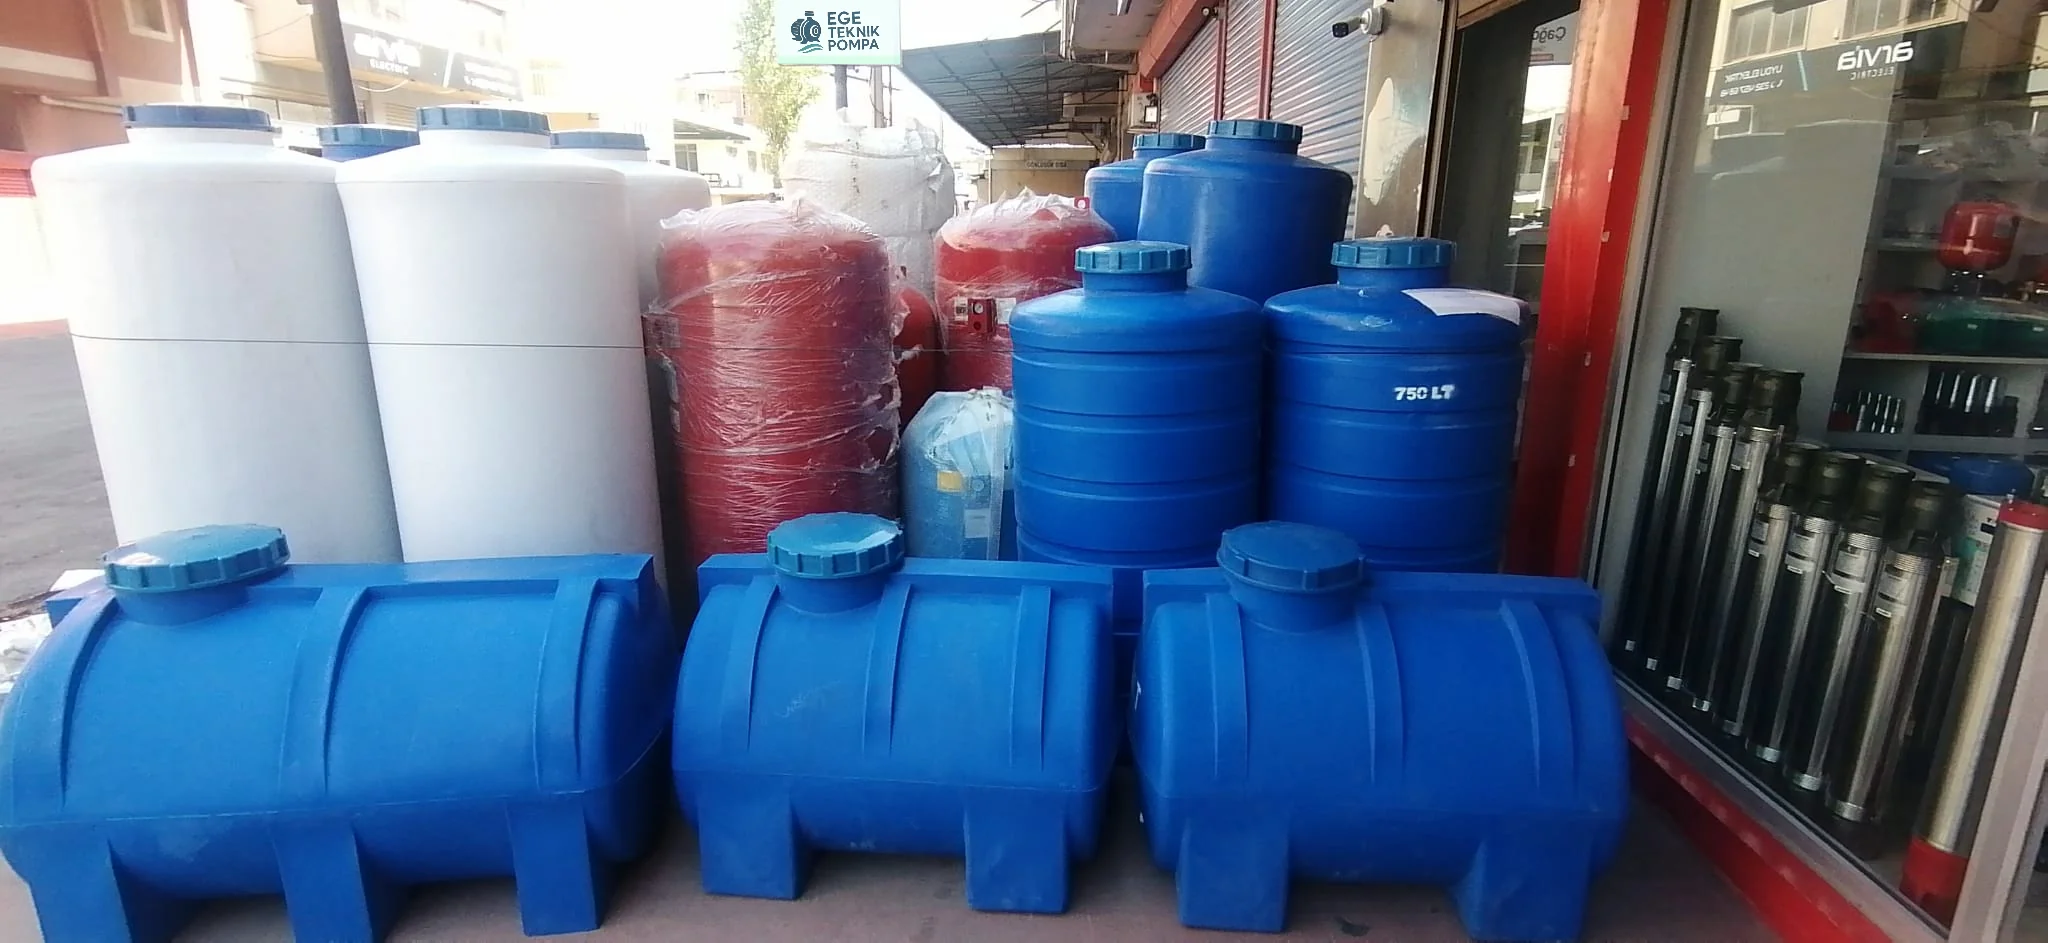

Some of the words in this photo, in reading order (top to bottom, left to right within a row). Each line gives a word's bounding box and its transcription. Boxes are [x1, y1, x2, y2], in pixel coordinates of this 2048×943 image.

[827, 11, 861, 25] EGE
[828, 26, 880, 38] TEKNIK
[828, 39, 880, 51] POMPA
[1394, 386, 1428, 400] 750
[1431, 384, 1456, 400] LT
